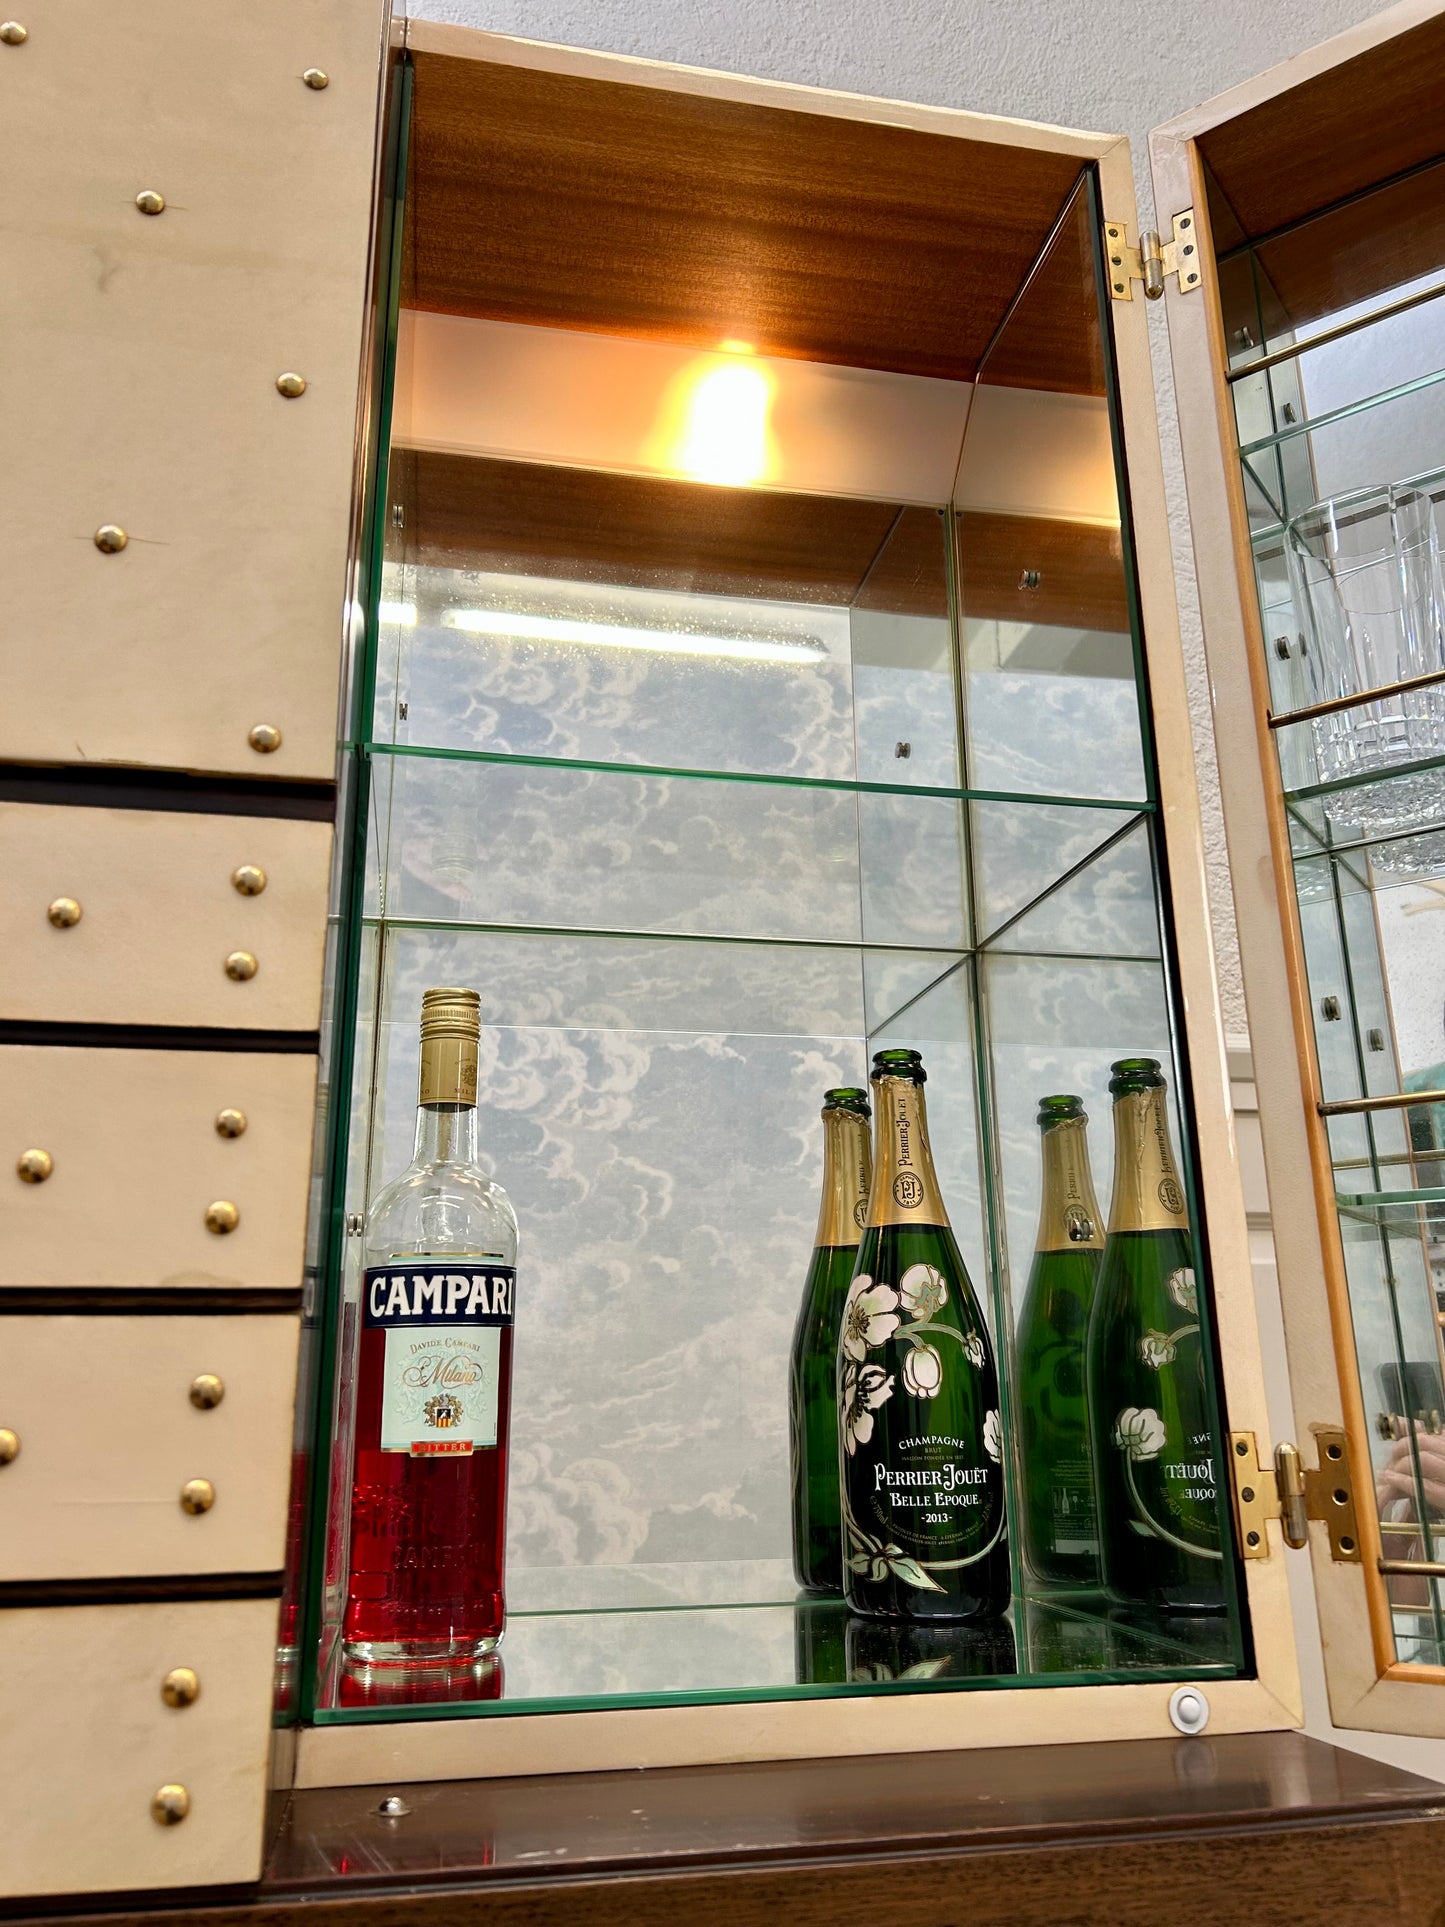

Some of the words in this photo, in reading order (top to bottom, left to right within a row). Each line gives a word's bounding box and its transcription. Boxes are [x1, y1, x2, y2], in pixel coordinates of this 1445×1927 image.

[369, 1274, 514, 1318] CAMPARI
[409, 1339, 442, 1355] DAVIDE
[444, 1337, 481, 1353] CAMPARI
[402, 1354, 484, 1390] Milano
[898, 1435, 966, 1450] CHAMPAGNE
[924, 1446, 942, 1454] BRUT
[873, 1462, 989, 1491] PERRIER-JOUËT
[889, 1492, 932, 1507] BELLE
[934, 1491, 979, 1508] EPOQUE
